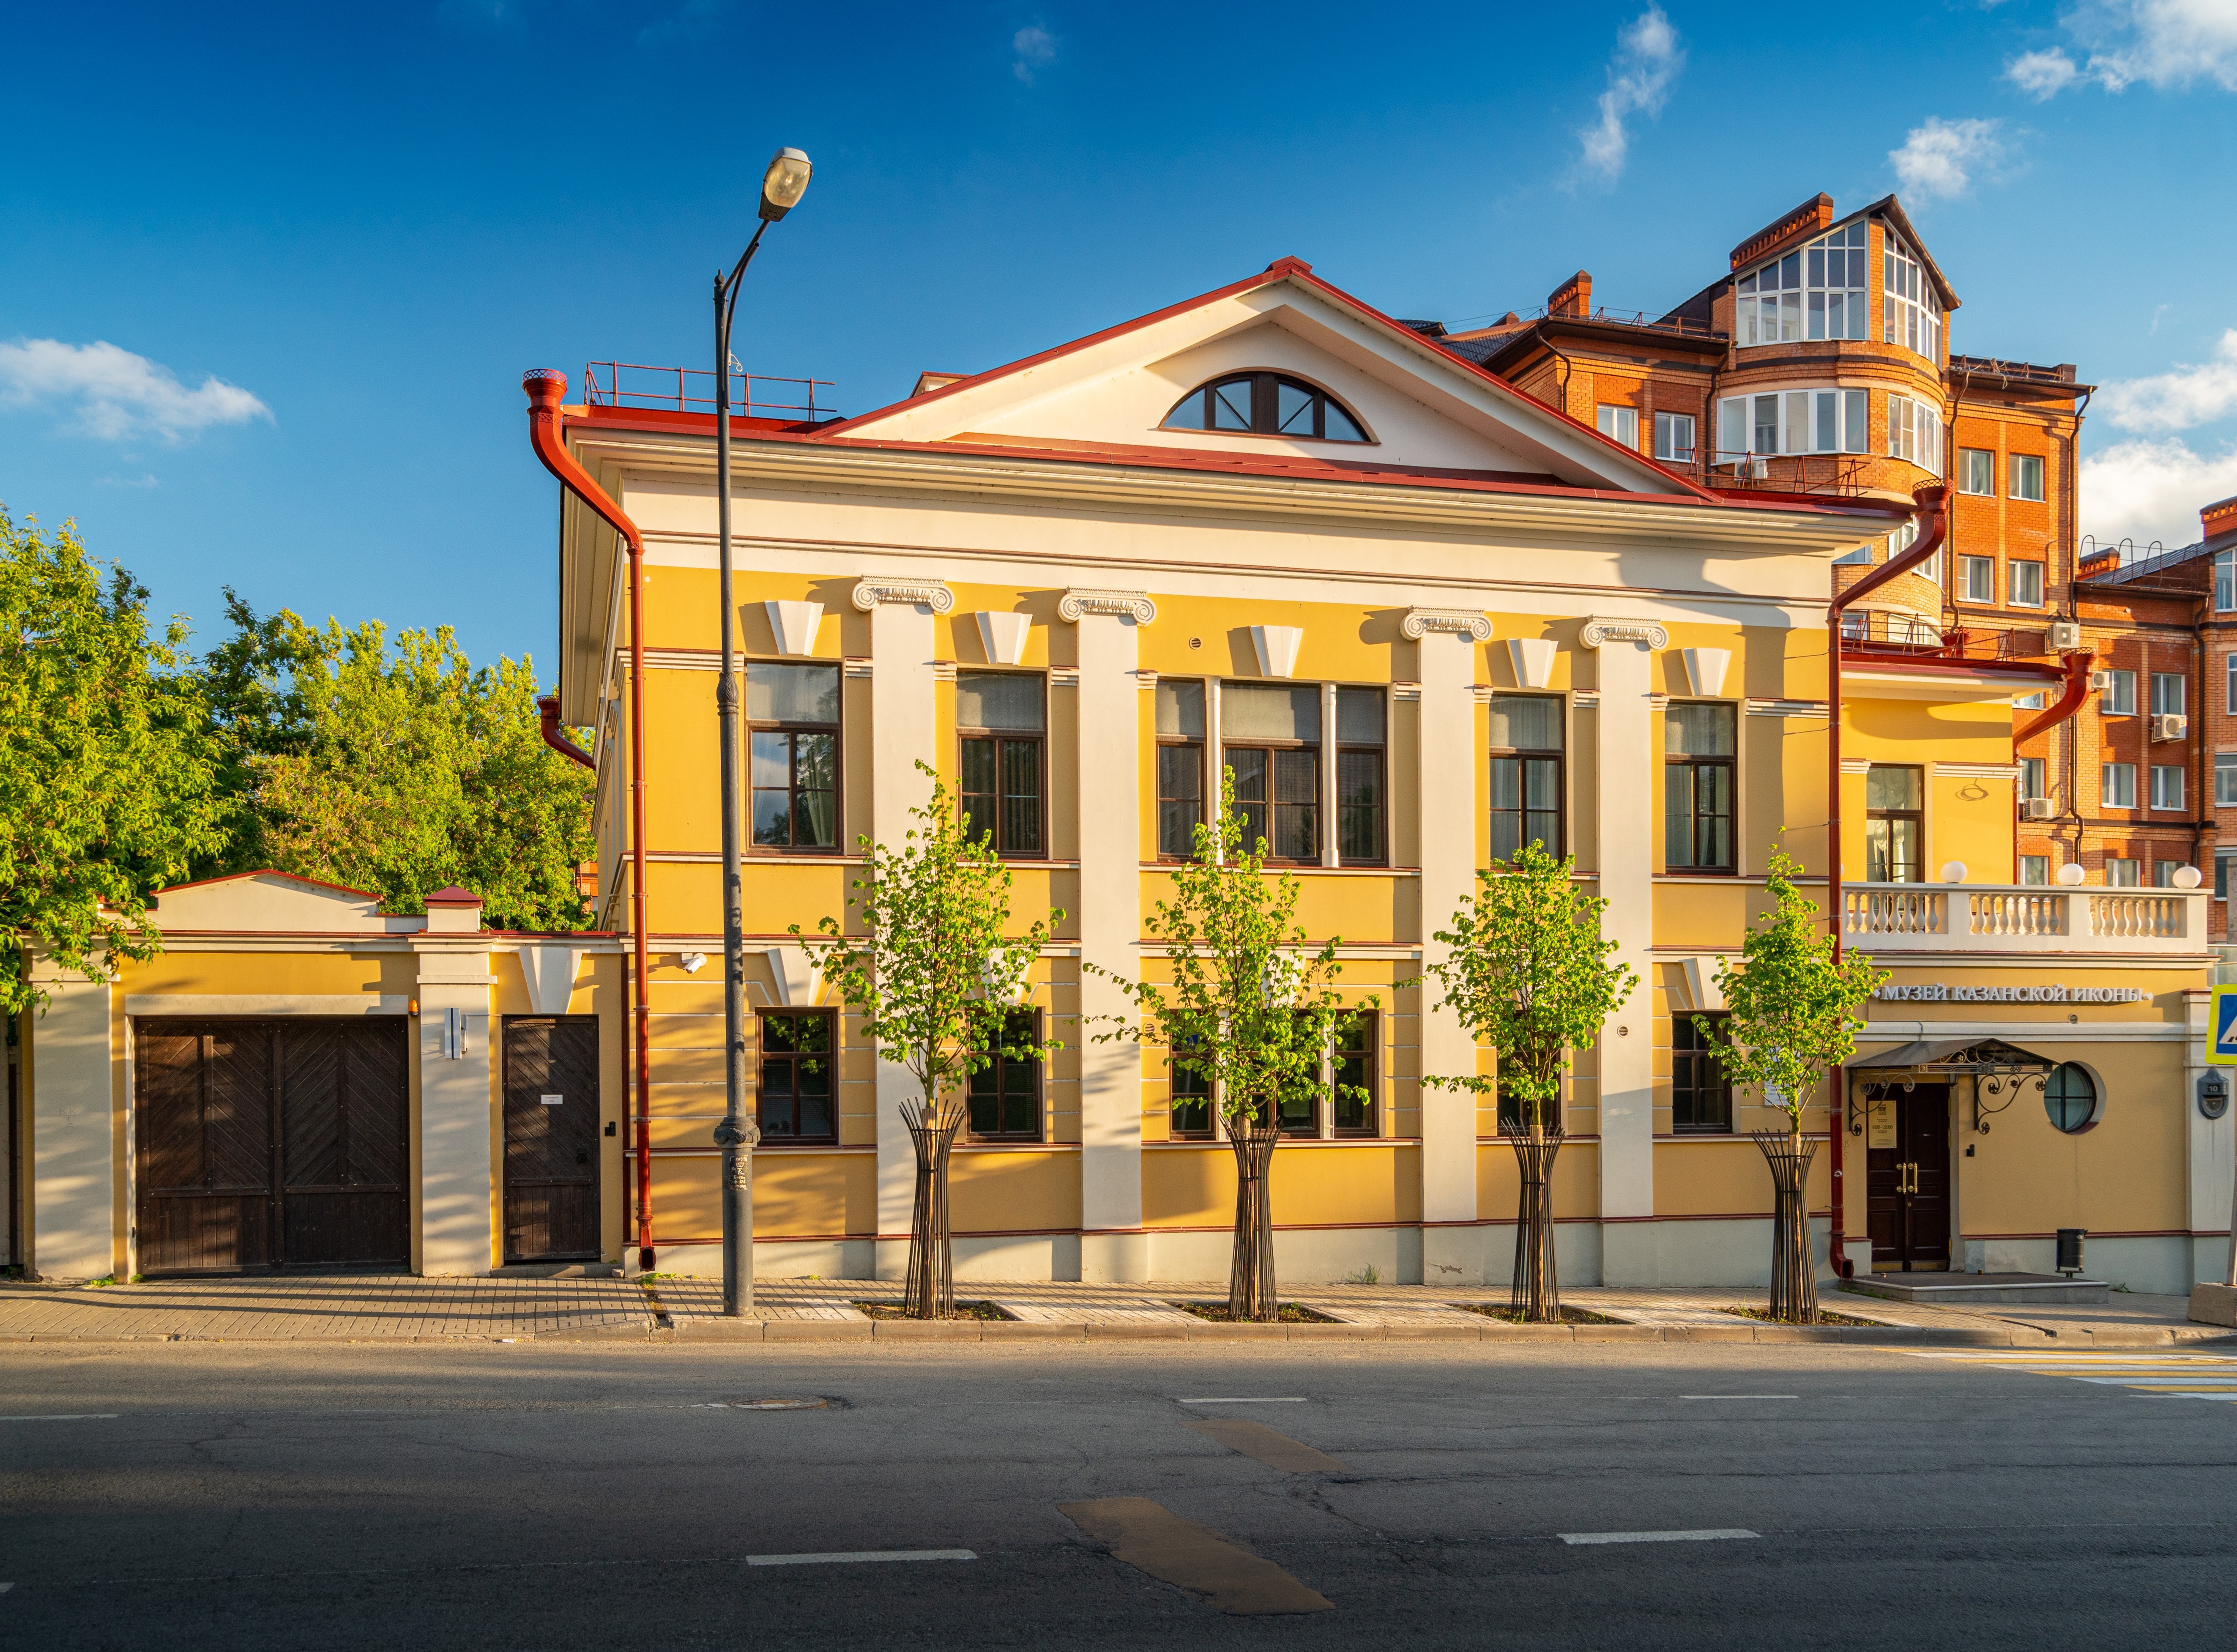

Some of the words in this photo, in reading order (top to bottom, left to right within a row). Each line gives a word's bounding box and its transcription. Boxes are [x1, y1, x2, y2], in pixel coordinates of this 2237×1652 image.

[1884, 982, 1948, 1000] МУЗЕЙ
[1954, 984, 2067, 1001] КАЗАНСКОЙ
[2074, 987, 2143, 1002] ИКОНЫ
